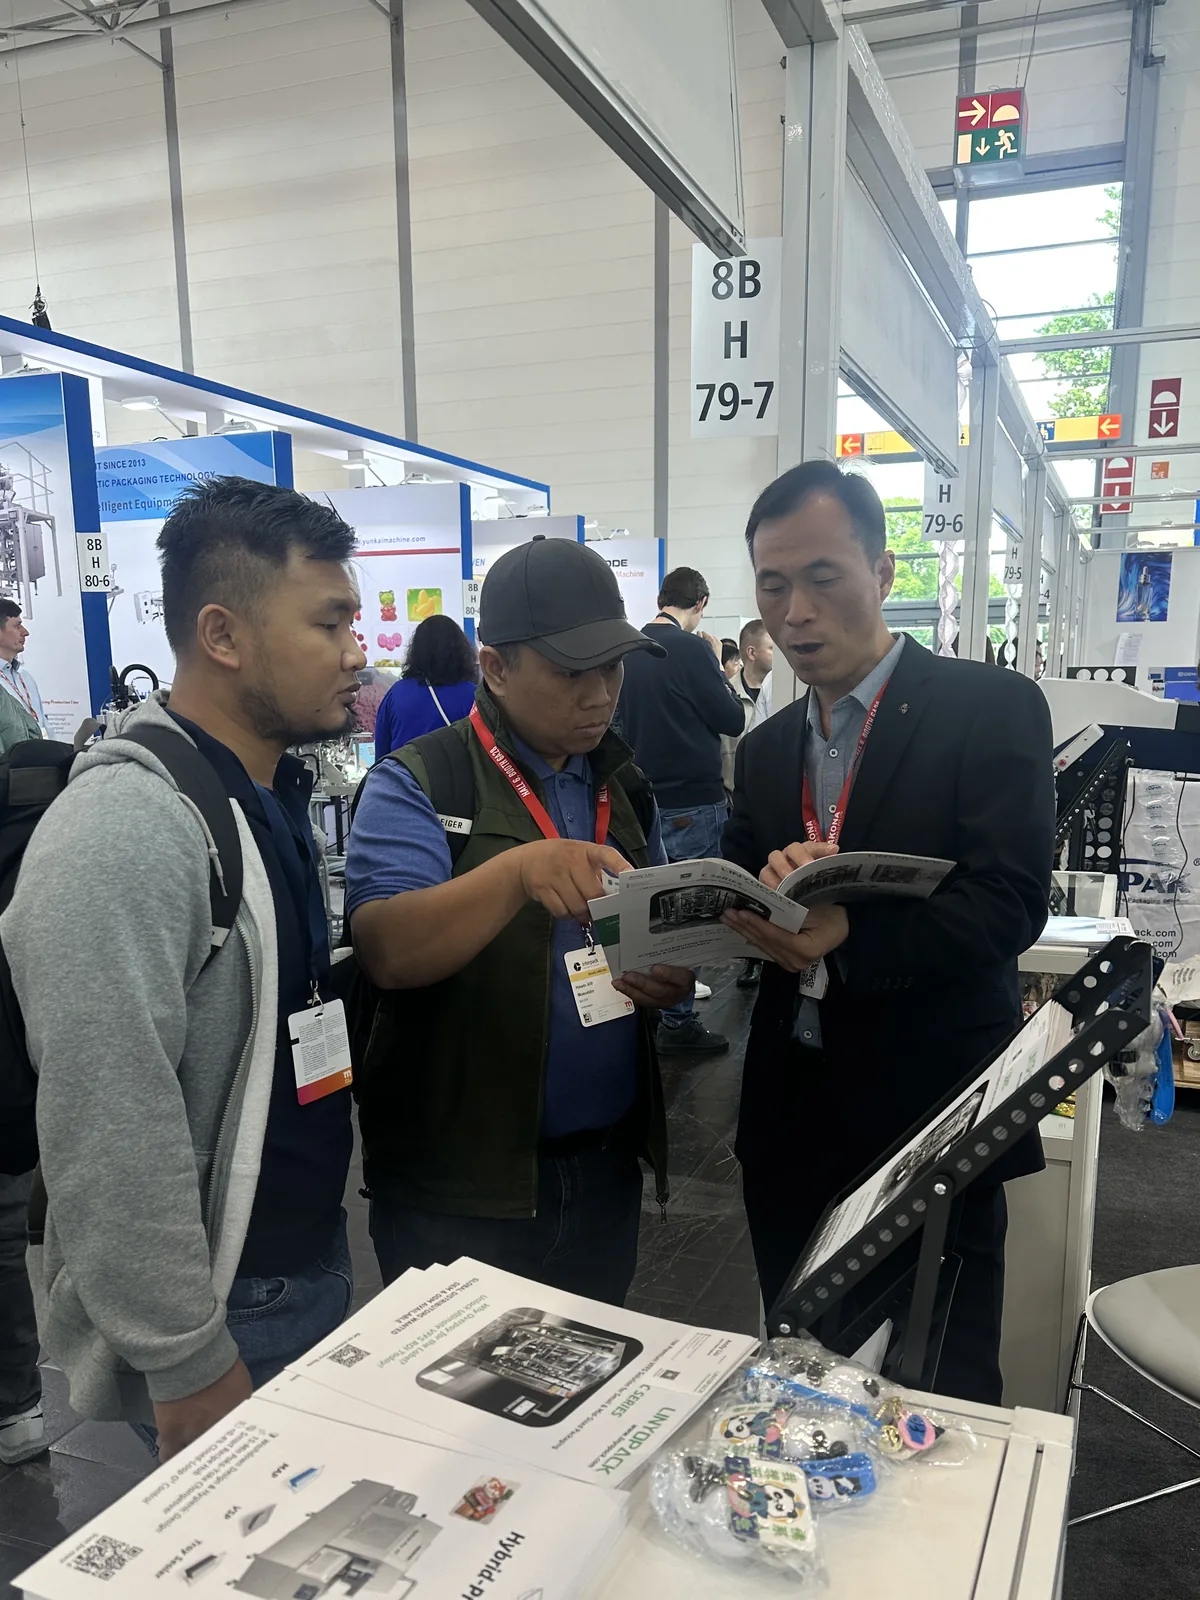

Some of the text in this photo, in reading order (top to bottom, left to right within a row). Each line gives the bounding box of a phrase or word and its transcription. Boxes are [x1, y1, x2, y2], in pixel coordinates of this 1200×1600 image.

[711, 259, 762, 301] 8B
[723, 320, 748, 359] H
[695, 380, 775, 422] 79-7
[103, 460, 127, 470] SINCE
[128, 458, 146, 468] 2013
[111, 475, 158, 488] PACKAGING
[160, 470, 216, 483] TECHNOLOGY
[938, 484, 952, 504] H
[924, 514, 964, 534] 79-6
[86, 538, 102, 551] 8B
[1012, 546, 1018, 560] H
[92, 556, 100, 568] H
[84, 574, 110, 587] 80-6
[616, 570, 644, 578] Machine
[1004, 566, 1022, 580] 79-5
[468, 584, 479, 592] 8B
[470, 594, 477, 603] H
[861, 716, 874, 738] BOOTH
[498, 758, 517, 778] BOOTH
[514, 781, 530, 798] HALL
[445, 1280, 460, 1292] OEM
[390, 1276, 479, 1336] GLOBAL DISTRIBUTORS WANTED
[426, 1291, 441, 1304] ODM
[394, 1300, 428, 1325] AVAILABLE
[376, 1292, 487, 1369] Unlock Ultimate VFFS ROI Today!
[398, 1300, 490, 1366] Why Overpay for the Label?
[652, 1343, 672, 1364] Premium
[624, 1369, 644, 1388] Solution
[604, 1391, 620, 1406] Small
[610, 1381, 651, 1420] C SERIES
[577, 1406, 603, 1429] Mid-Sized
[551, 1425, 580, 1452] Packaging
[587, 1422, 638, 1470] www.linyopack.com
[595, 1401, 677, 1479] LINYOPACK
[192, 1429, 248, 1478] Smart Recipe Hub
[234, 1436, 270, 1469] Washdown
[212, 1463, 237, 1486] Design
[270, 1461, 289, 1479] MAP
[141, 1480, 170, 1506] Control
[161, 1478, 204, 1516] Changeover
[178, 1486, 210, 1515] Hygienic
[222, 1503, 242, 1520] VSP
[154, 1510, 182, 1535] Design
[154, 1536, 203, 1580] Tray Sealer
